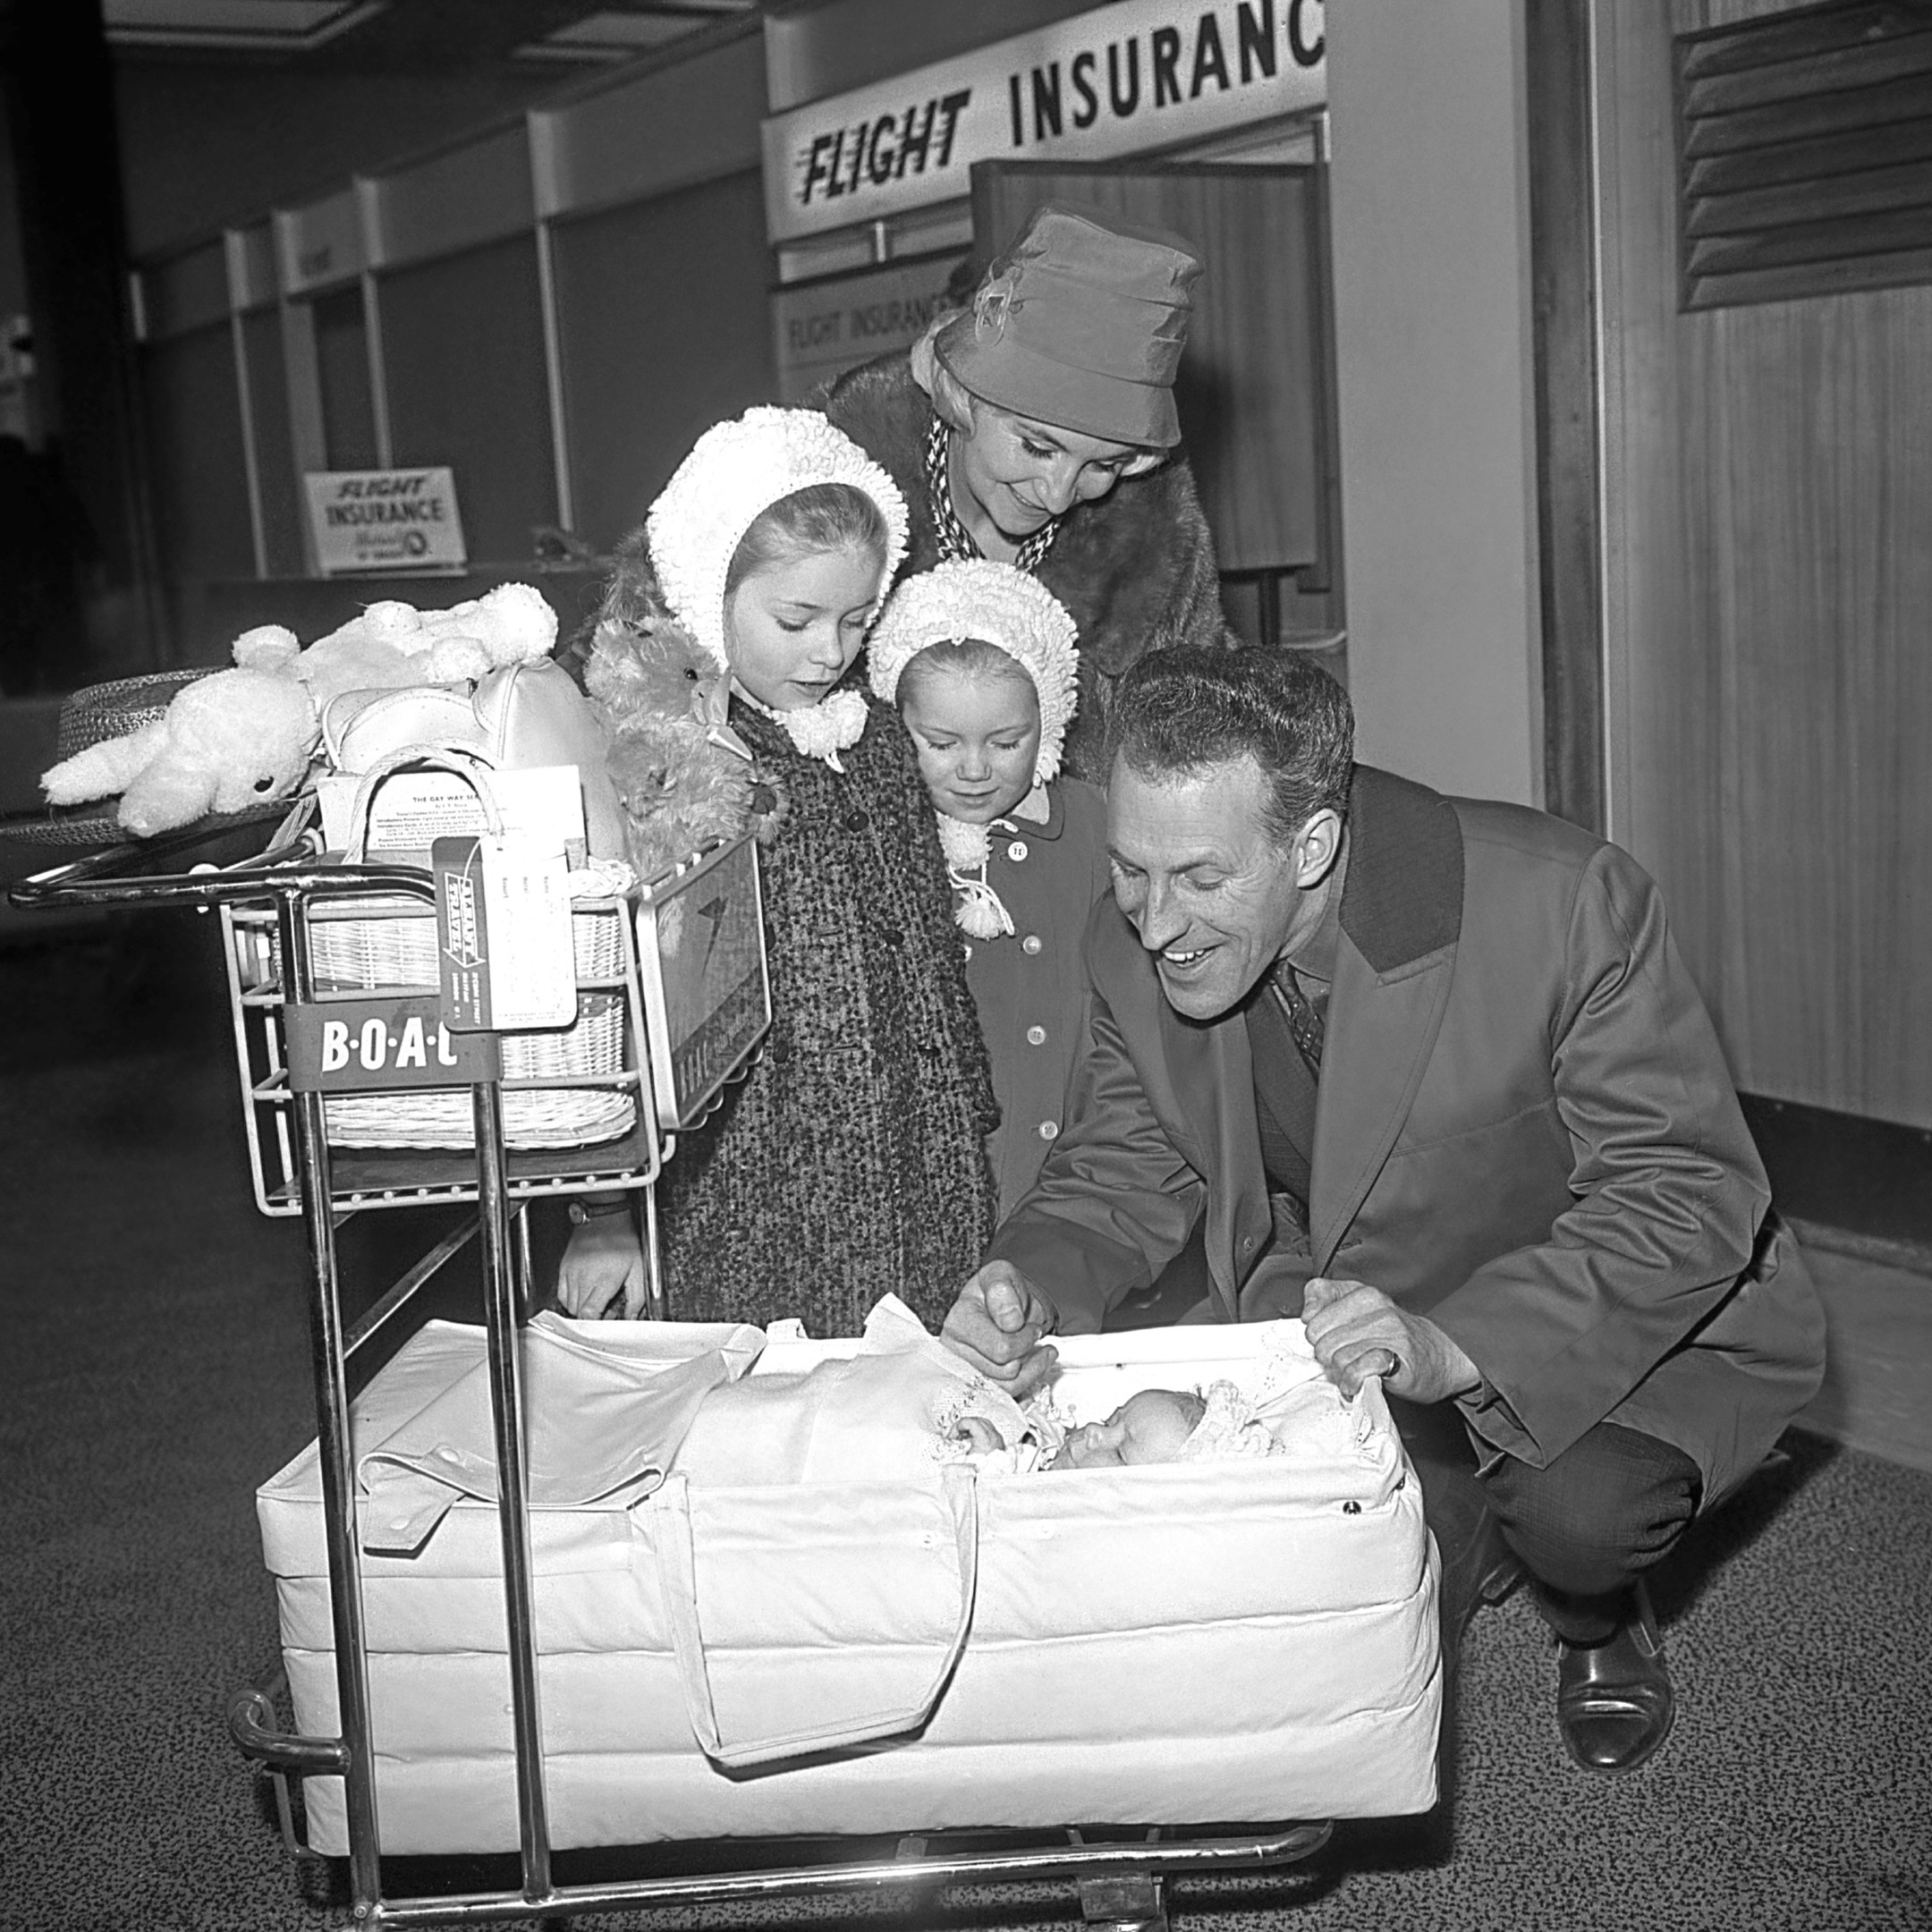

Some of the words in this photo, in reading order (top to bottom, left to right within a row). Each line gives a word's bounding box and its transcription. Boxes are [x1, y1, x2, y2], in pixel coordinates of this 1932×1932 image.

[801, 89, 971, 204] FLIGHT
[1010, 0, 1325, 147] INSURANC
[338, 477, 427, 498] FLIGHT
[326, 497, 444, 526] INSURANCE
[448, 883, 462, 953] TRAVEL
[452, 972, 460, 1002] LONDON
[473, 999, 481, 1025] STREET
